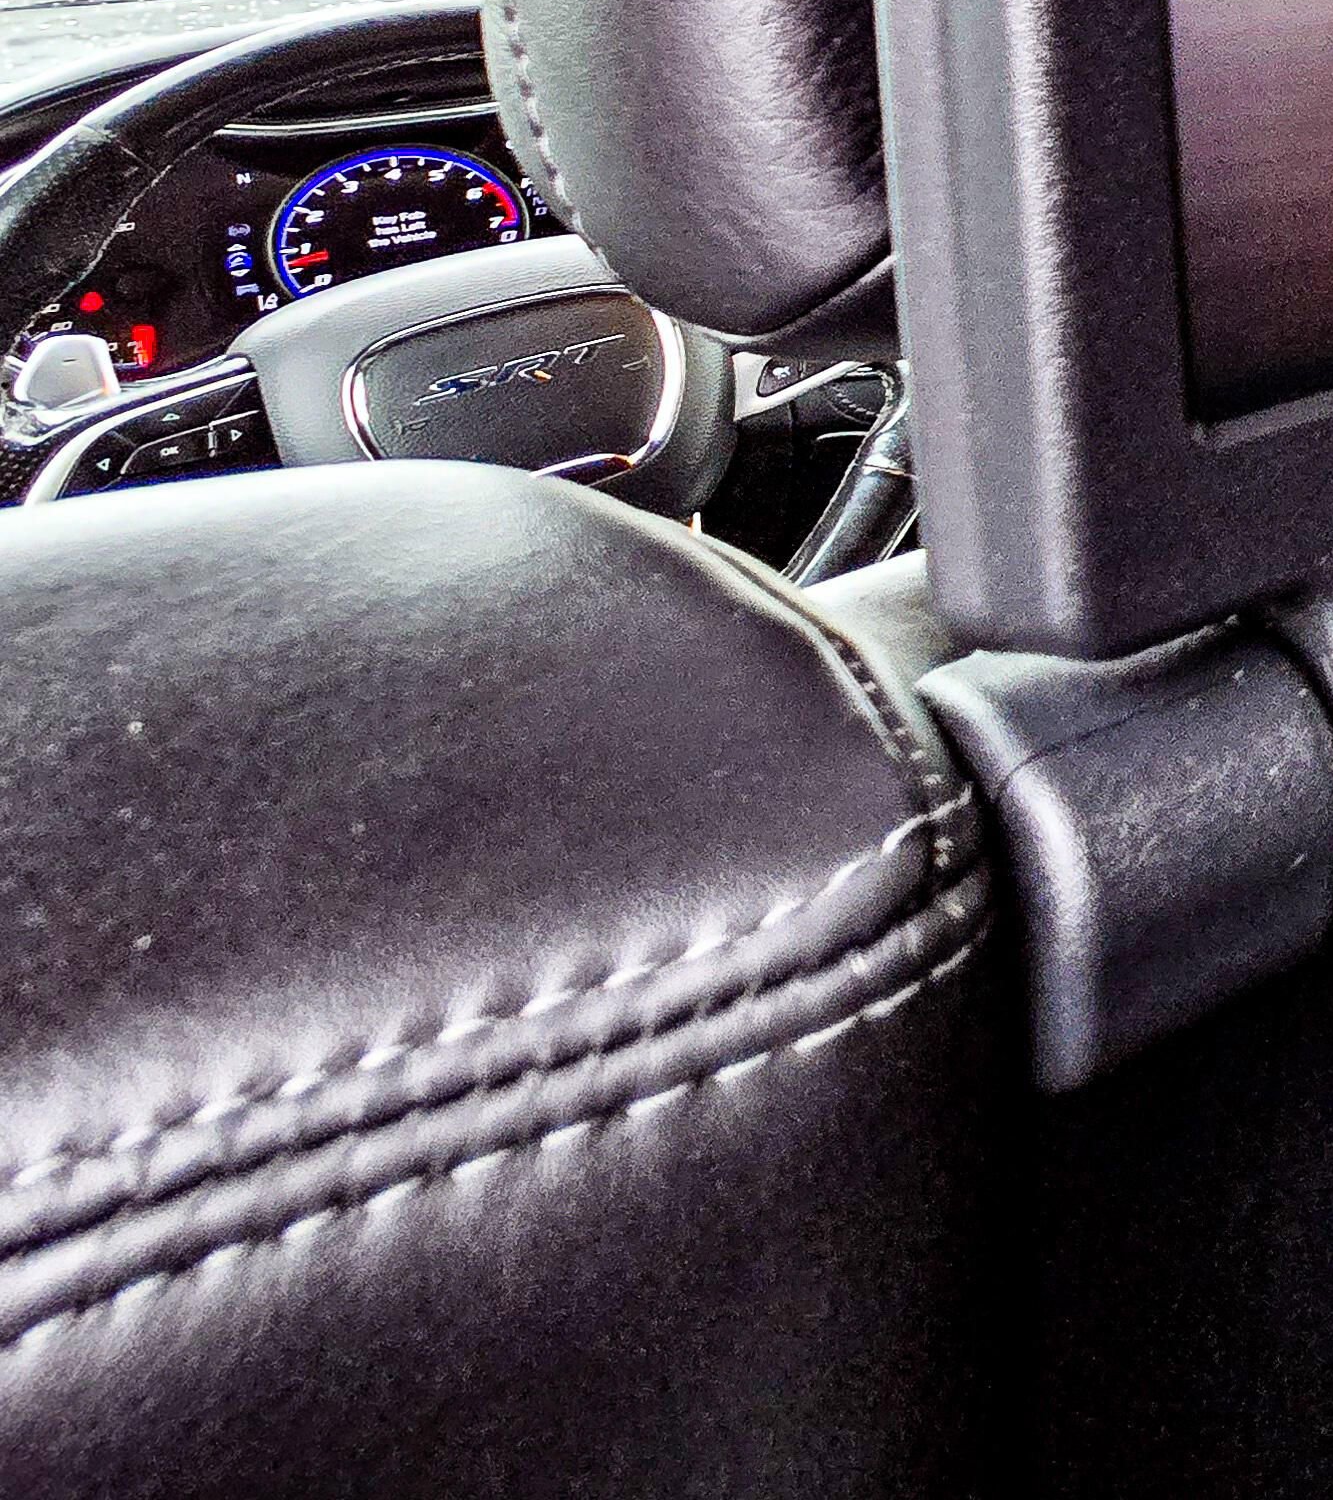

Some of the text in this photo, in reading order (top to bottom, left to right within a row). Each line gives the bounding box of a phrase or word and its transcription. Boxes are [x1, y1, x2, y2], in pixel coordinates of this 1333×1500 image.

[235, 173, 251, 185] N
[384, 168, 402, 180] 4
[428, 169, 446, 181] 5
[341, 181, 359, 193] 3
[466, 187, 483, 200] 6
[305, 210, 325, 223] 2
[488, 216, 504, 228] 7
[300, 243, 311, 255] 1
[314, 274, 333, 286] 0
[413, 333, 626, 406] SRT
